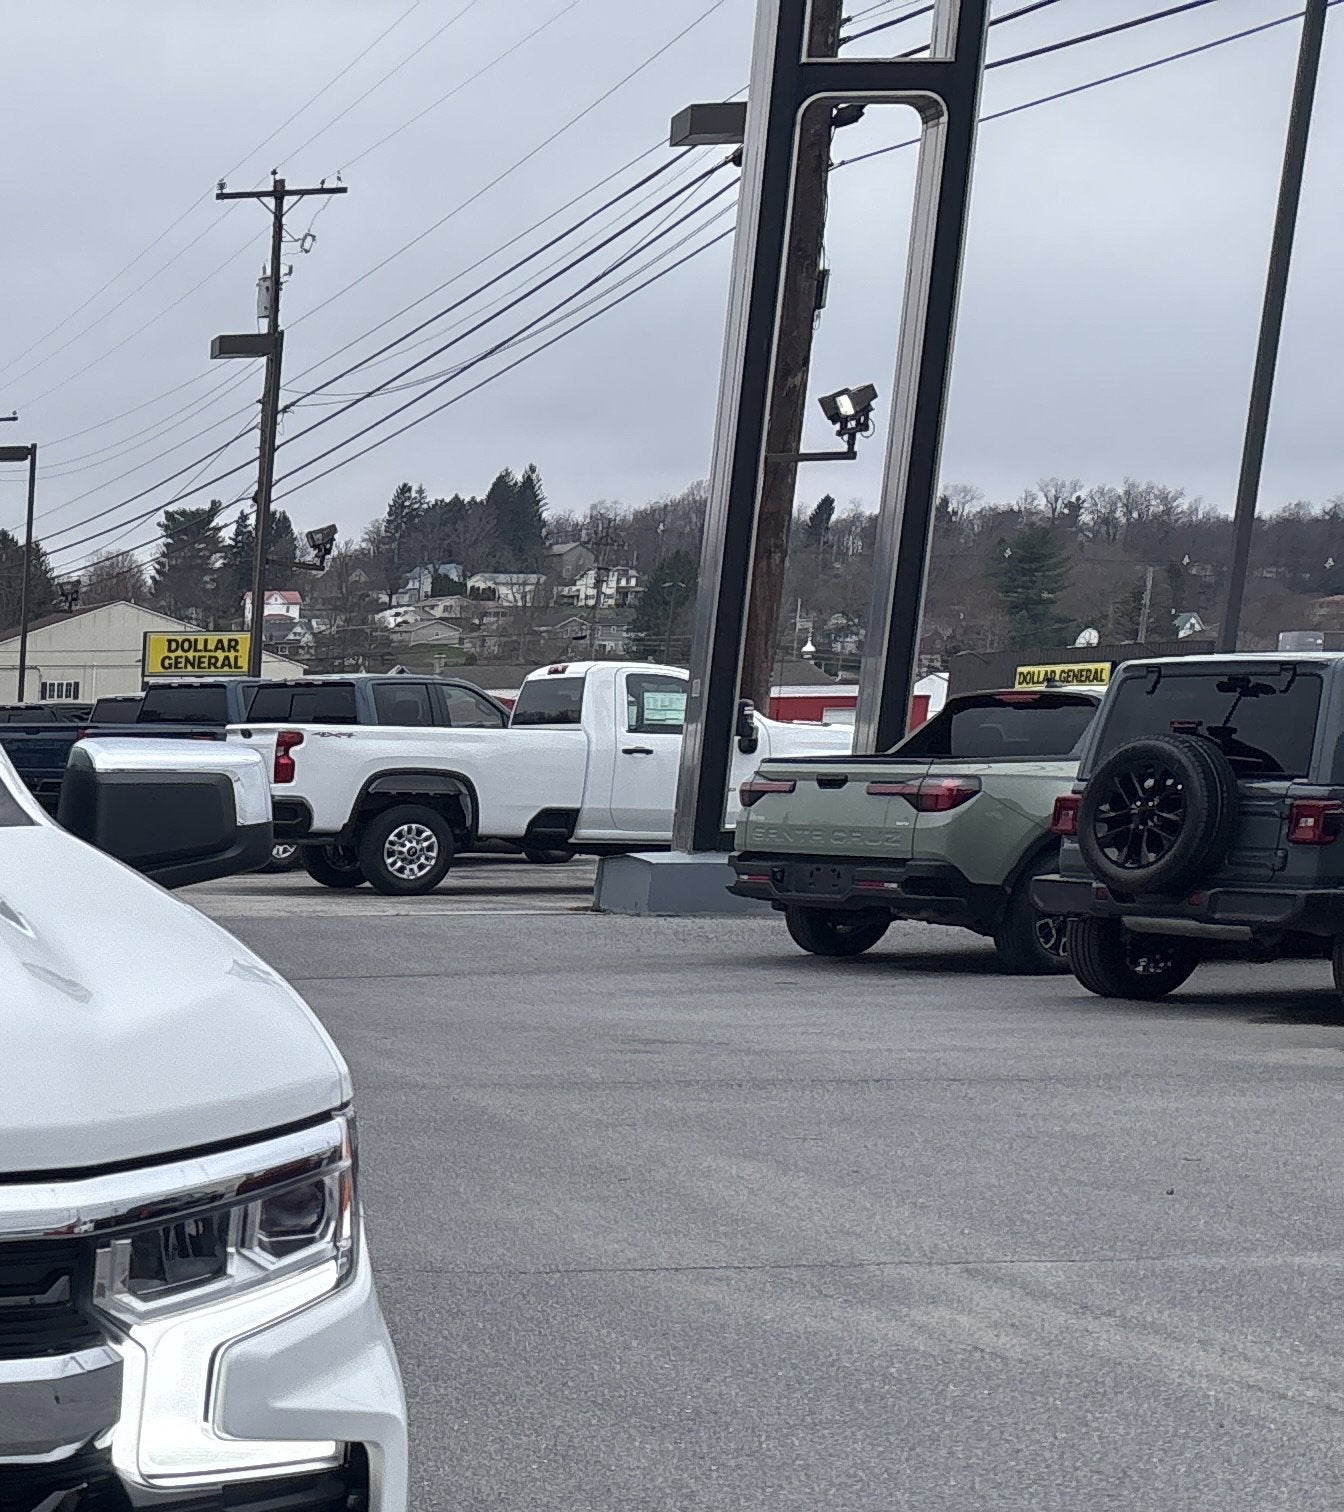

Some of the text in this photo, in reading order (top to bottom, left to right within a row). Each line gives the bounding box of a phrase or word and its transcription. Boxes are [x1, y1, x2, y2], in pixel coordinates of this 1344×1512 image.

[166, 638, 240, 653] DOLLAR
[160, 655, 243, 670] GENERAL
[1017, 668, 1106, 685] DOLLAR GENERAL
[830, 829, 903, 846] CRUZ
